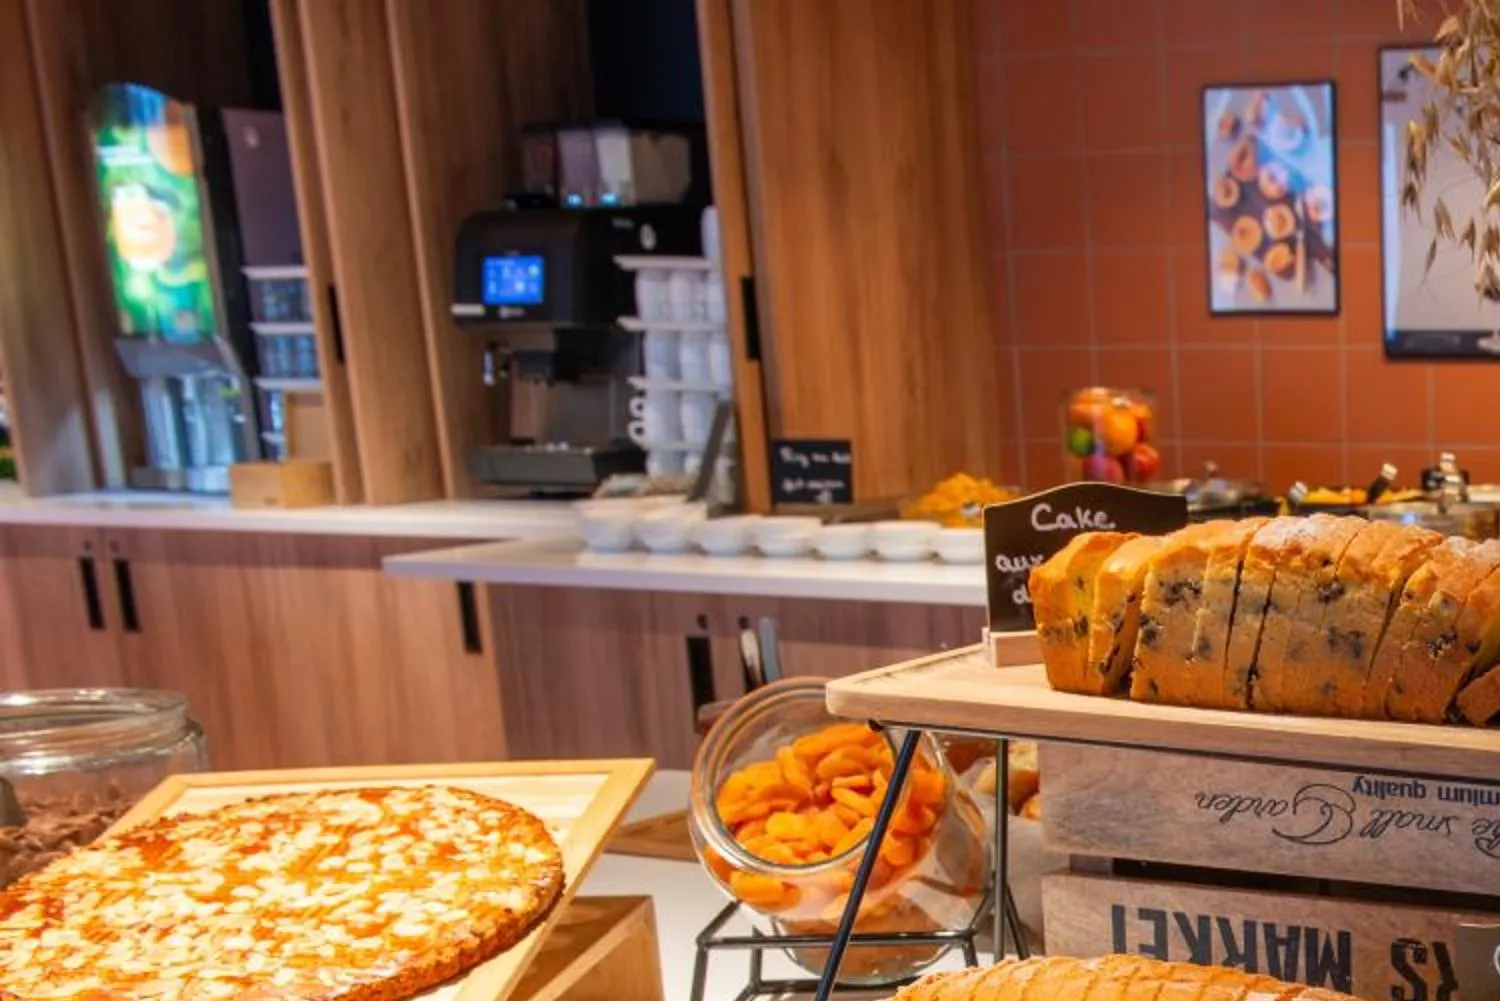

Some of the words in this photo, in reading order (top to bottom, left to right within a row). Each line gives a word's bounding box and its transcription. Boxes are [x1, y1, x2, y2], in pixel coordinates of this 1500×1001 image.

[1031, 503, 1116, 532] Cake
[1352, 775, 1427, 800] quality
[1194, 784, 1355, 846] Garden
[1360, 810, 1459, 839] small
